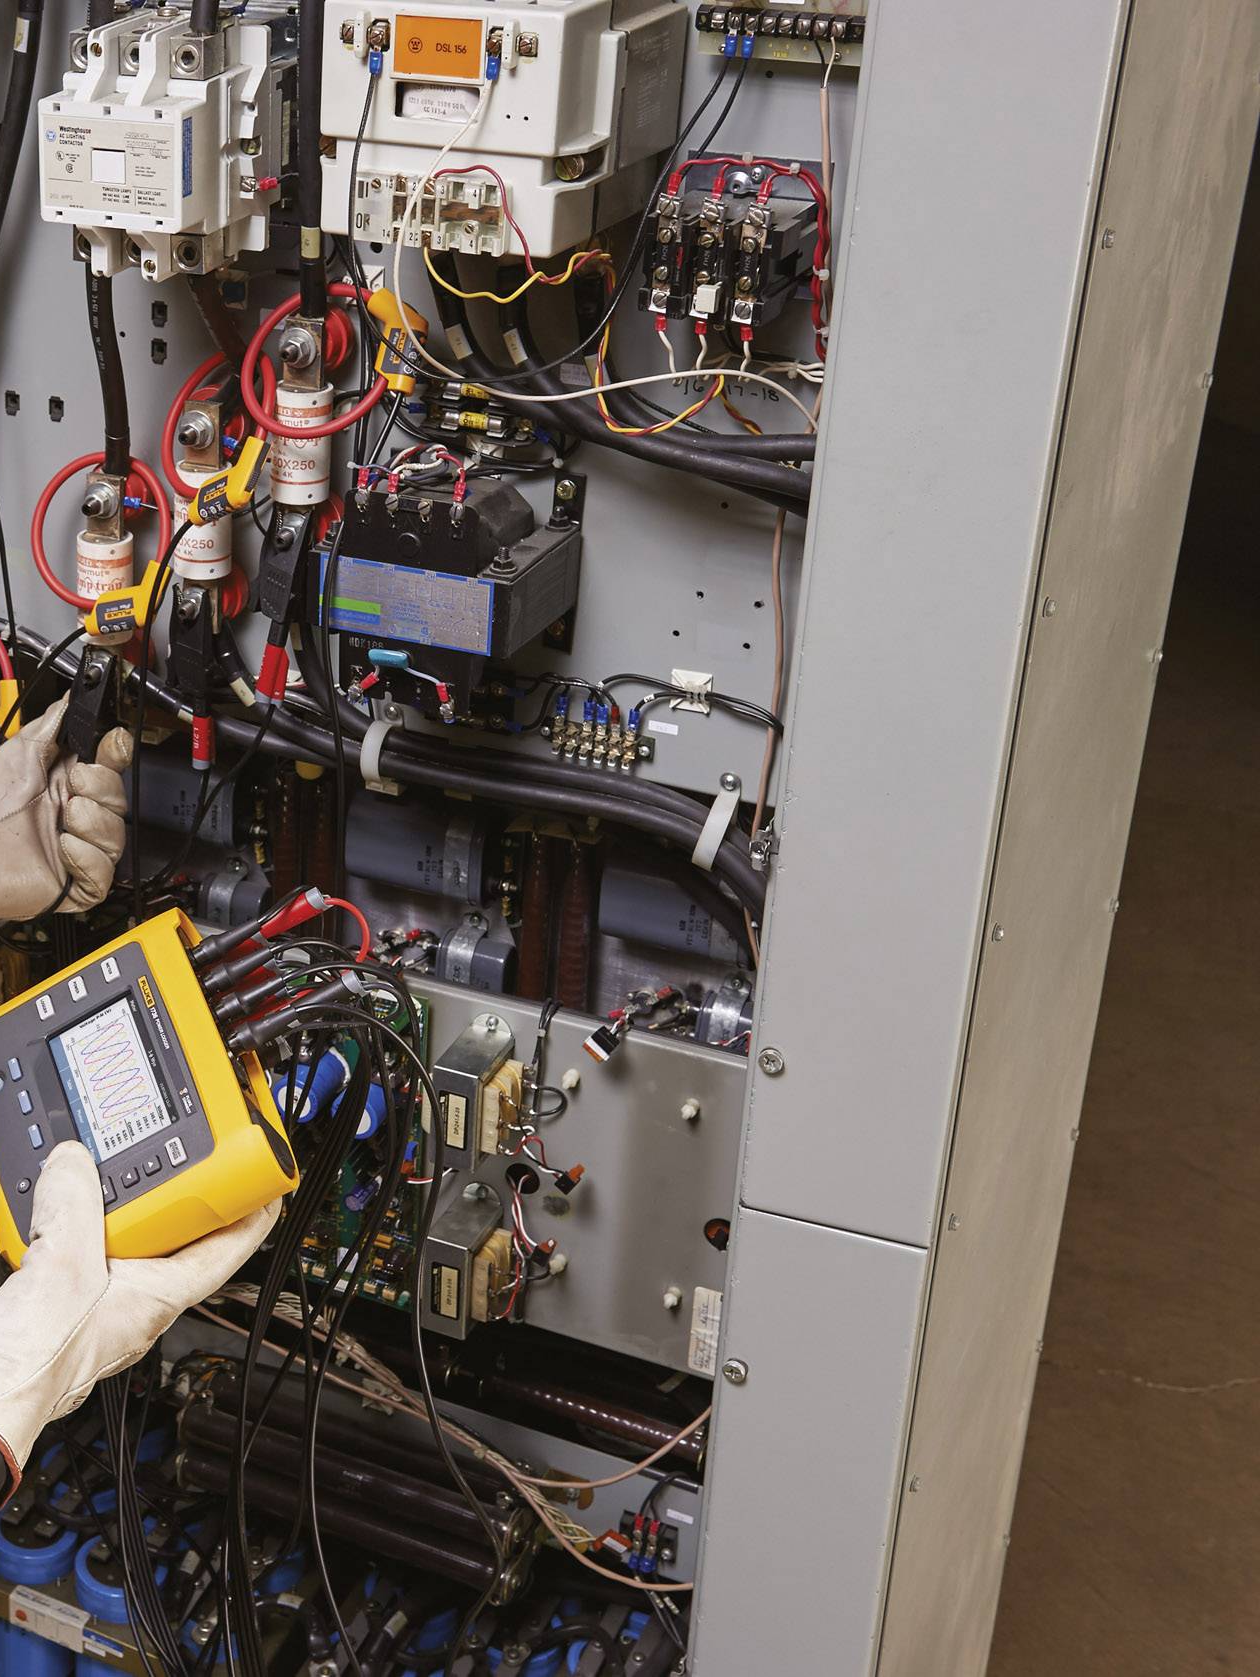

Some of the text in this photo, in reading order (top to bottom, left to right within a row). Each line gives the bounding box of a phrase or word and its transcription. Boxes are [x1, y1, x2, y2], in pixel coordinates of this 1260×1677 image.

[436, 42, 467, 55] DSL 156
[59, 126, 91, 134] Westinghouse
[140, 980, 153, 1005] FLUKE
